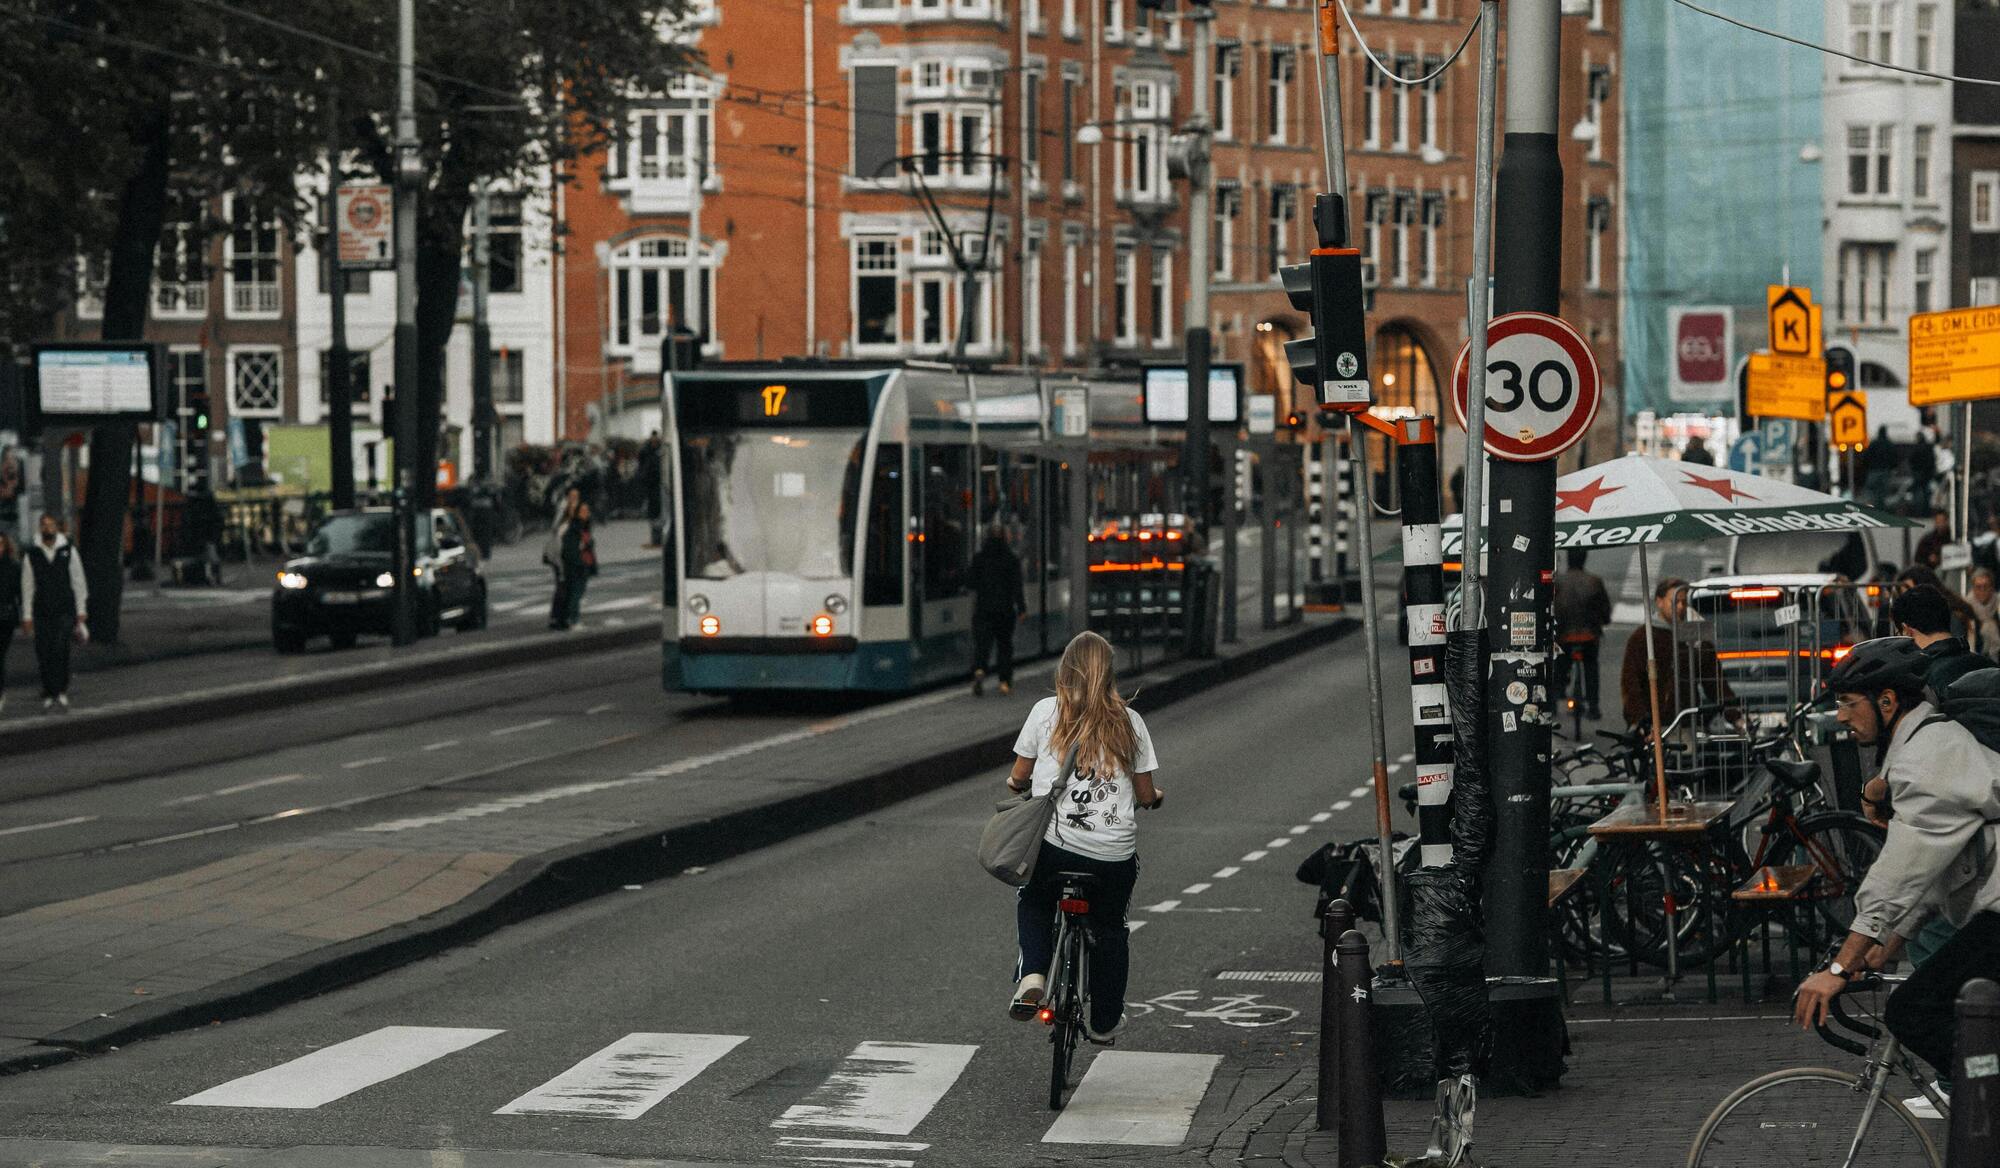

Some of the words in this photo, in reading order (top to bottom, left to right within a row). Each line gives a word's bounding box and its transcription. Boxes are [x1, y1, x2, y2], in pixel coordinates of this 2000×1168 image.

[1783, 319, 1799, 342] K
[1486, 360, 1572, 413] 30
[761, 385, 787, 416] 17
[1768, 421, 1787, 446] P
[1842, 417, 1857, 436] P
